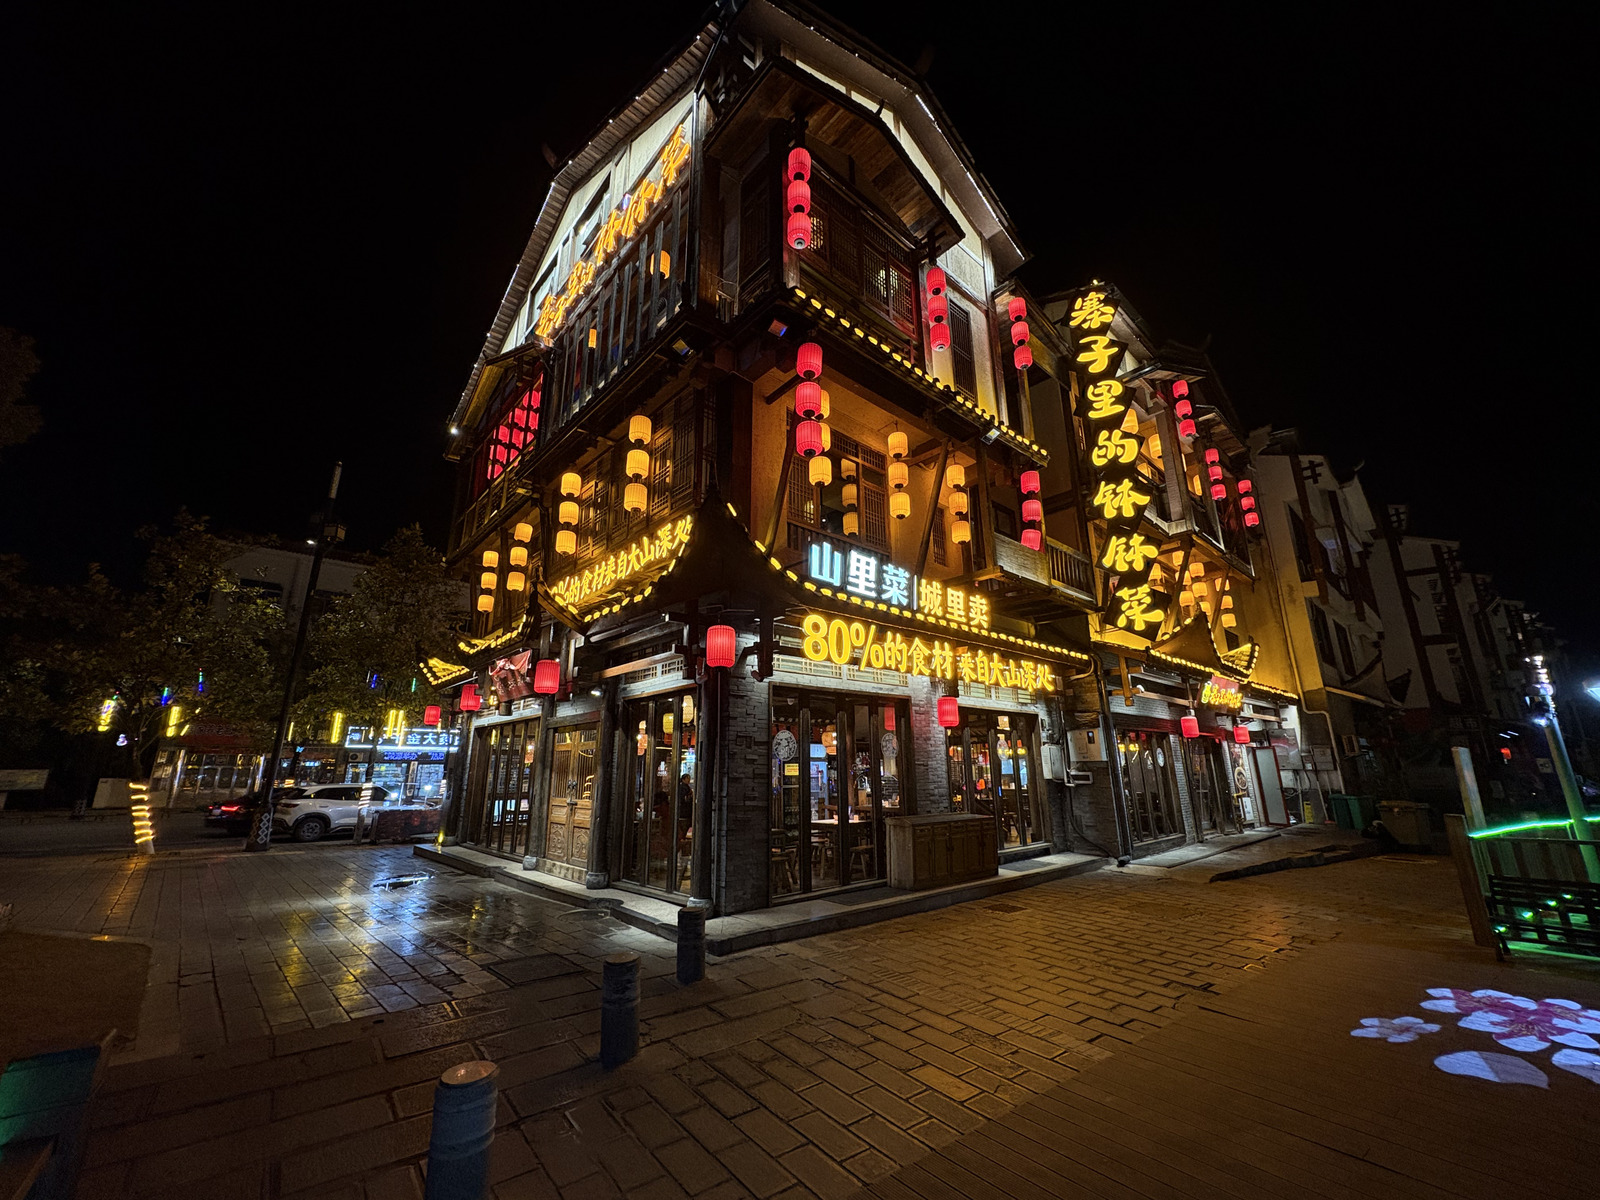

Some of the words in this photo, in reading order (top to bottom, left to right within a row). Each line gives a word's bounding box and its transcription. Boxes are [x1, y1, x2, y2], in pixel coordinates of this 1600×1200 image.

[1069, 291, 1165, 631] 寨子里的钵钵菜
[811, 541, 909, 606] 山里菜
[919, 579, 990, 628] 城里卖
[803, 614, 955, 680] 80%的食材
[957, 648, 1056, 693] 来自大山深处
